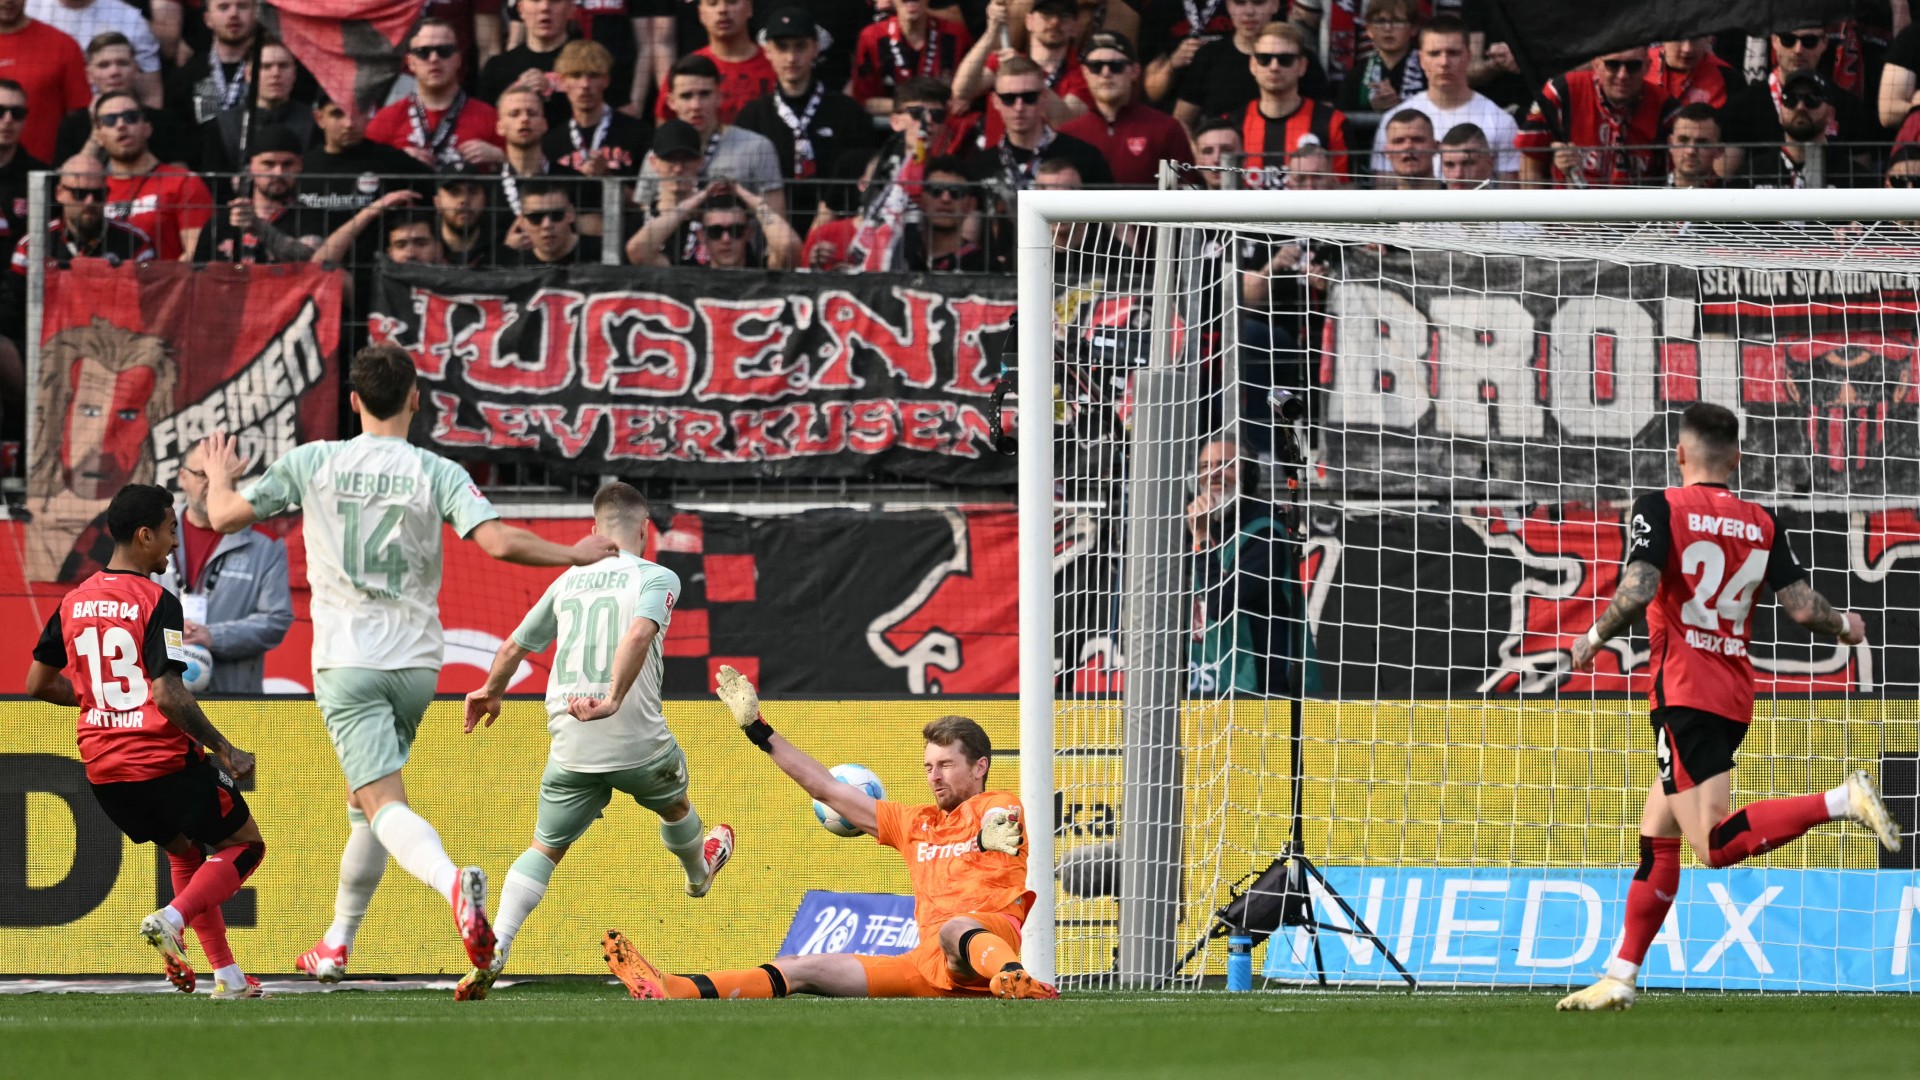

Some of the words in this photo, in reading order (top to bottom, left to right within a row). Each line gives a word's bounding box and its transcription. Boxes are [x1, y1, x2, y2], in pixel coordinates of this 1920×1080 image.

[1702, 268, 1788, 297] SEKTION
[334, 471, 415, 495] WERDER
[1687, 512, 1745, 539] BAYER
[337, 501, 409, 594] 14
[565, 571, 629, 592] WERDER
[1681, 540, 1771, 636] 24
[72, 600, 119, 619] BAYER
[120, 602, 139, 621] 04
[556, 596, 620, 685] 20
[73, 626, 149, 711] 13
[85, 708, 143, 728] ARTHUR
